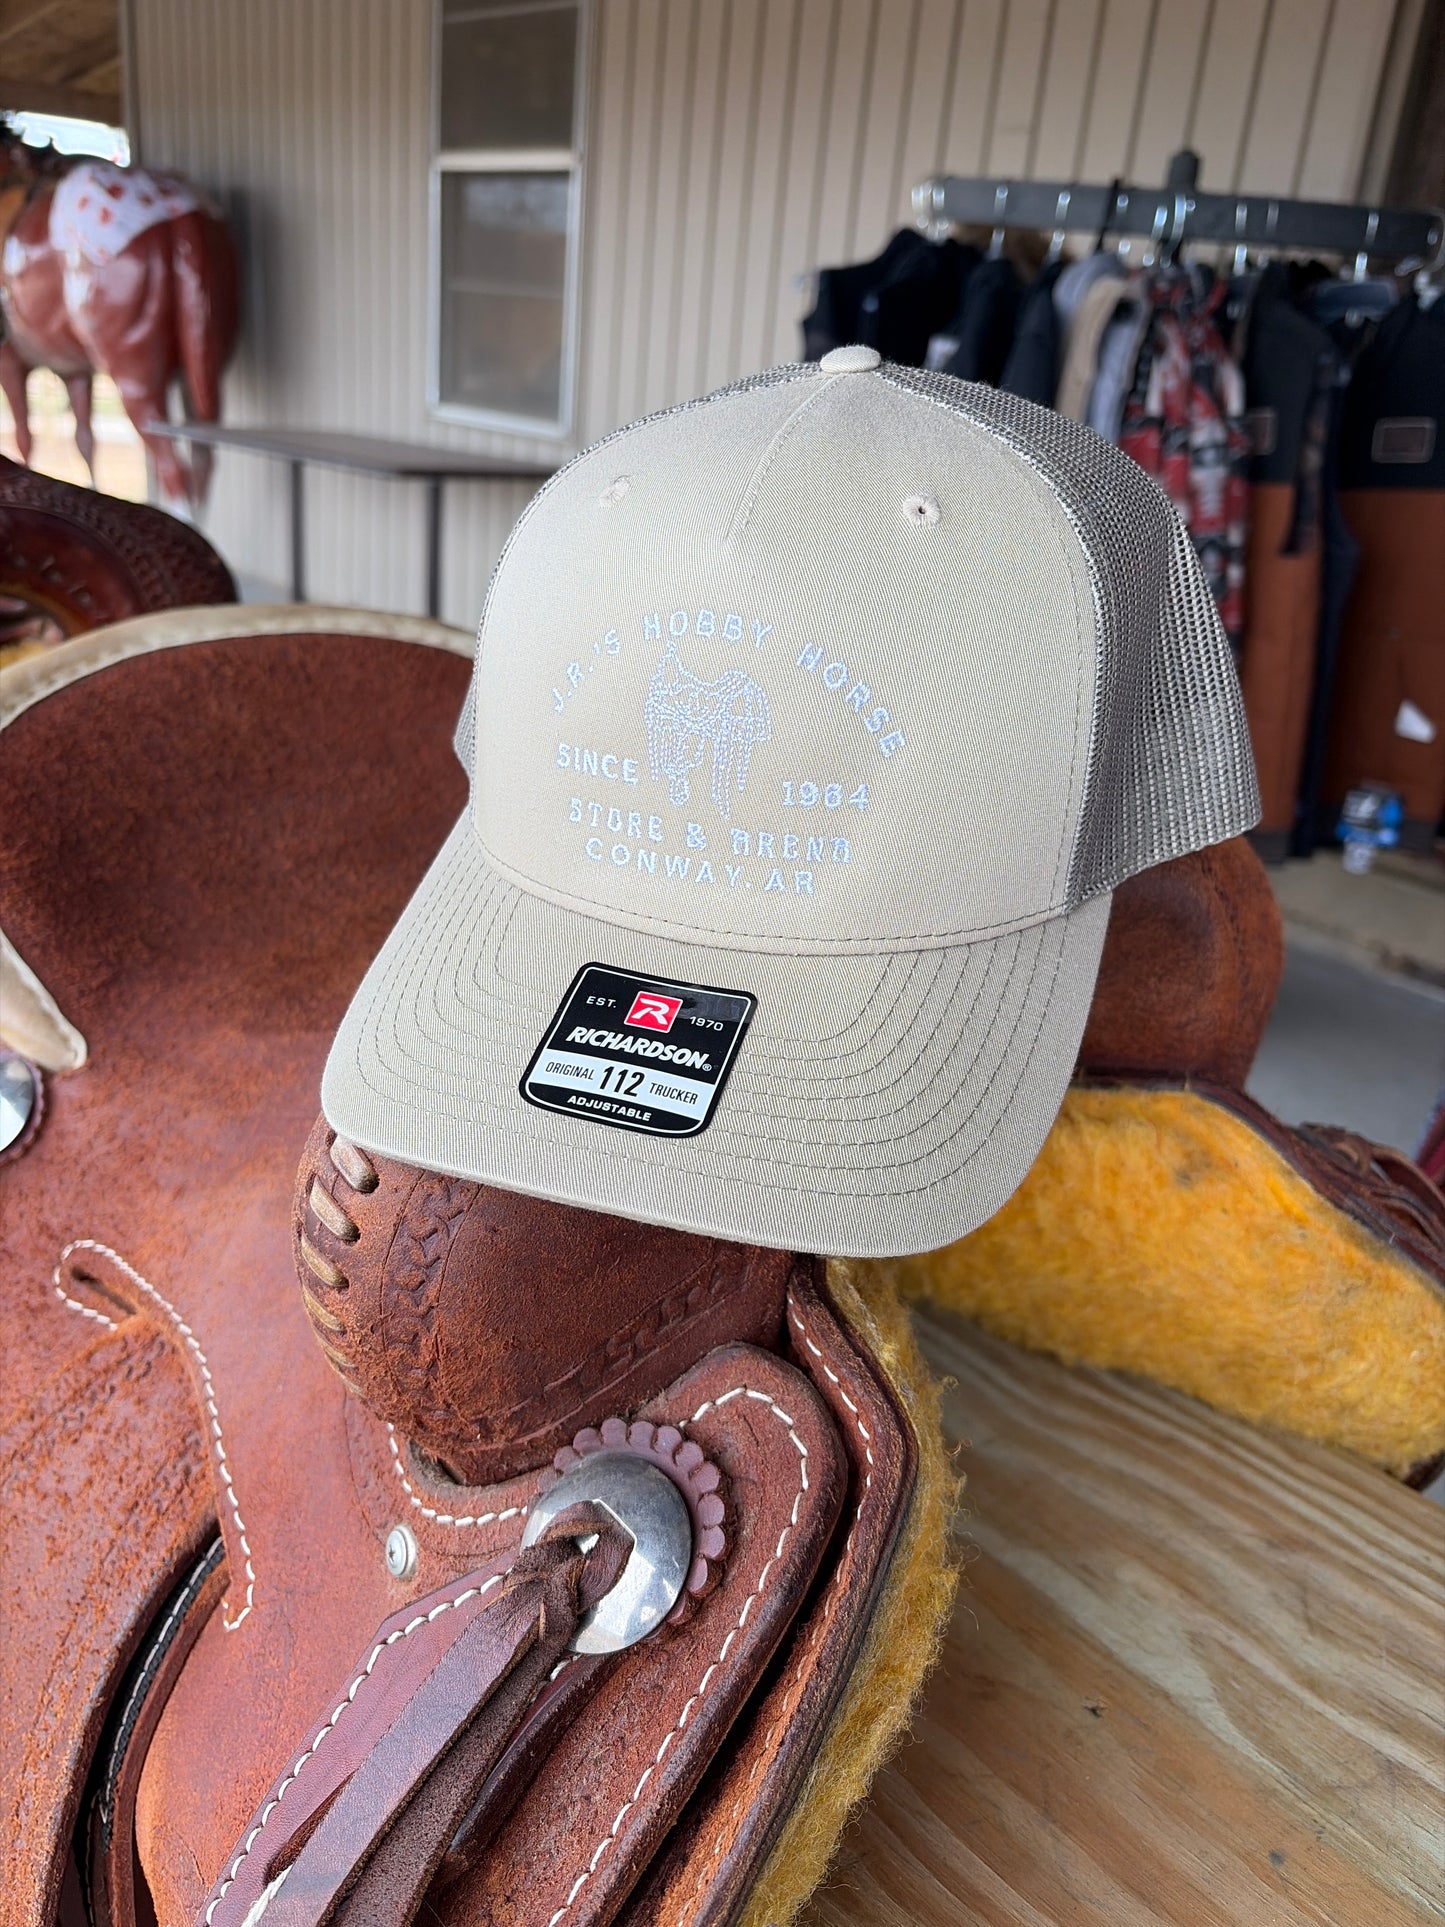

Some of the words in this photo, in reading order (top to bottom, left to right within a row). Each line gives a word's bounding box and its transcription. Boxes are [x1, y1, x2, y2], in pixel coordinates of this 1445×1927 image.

[642, 609, 773, 650] HOBBY
[796, 642, 907, 758] HORSE
[556, 743, 639, 786] SINCE
[568, 796, 664, 843] STORE
[686, 822, 706, 851] &
[731, 828, 852, 864] ARENA
[764, 868, 816, 895] AR
[586, 995, 617, 1009] EST.
[632, 998, 669, 1026] R
[689, 1015, 724, 1031] 1970
[545, 1061, 594, 1081] ORIGINAL
[599, 1065, 645, 1098] 112
[649, 1082, 698, 1105] TRUCKER
[567, 1095, 652, 1122] ADJUSTABLE
